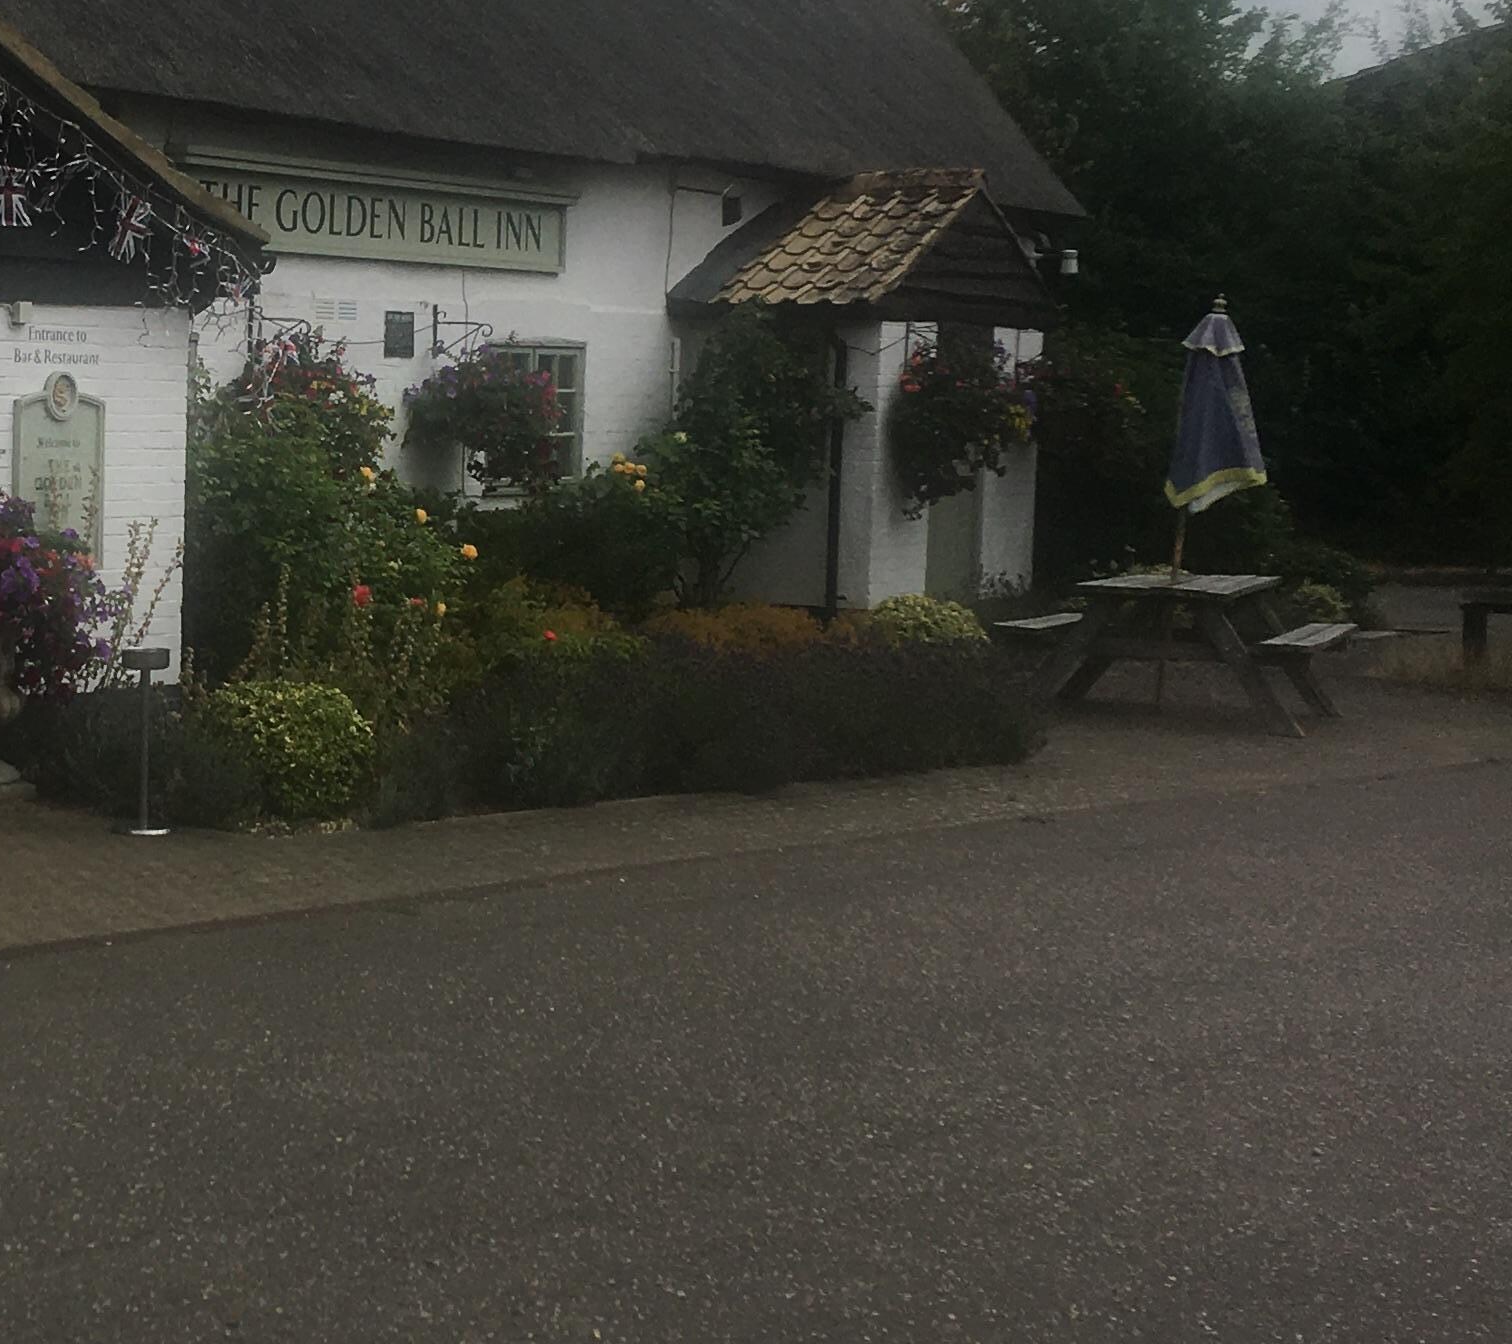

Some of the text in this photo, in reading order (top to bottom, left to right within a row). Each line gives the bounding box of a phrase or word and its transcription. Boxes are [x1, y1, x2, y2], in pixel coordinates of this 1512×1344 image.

[275, 188, 406, 240] GOLDEN
[419, 202, 485, 249] BALL
[496, 210, 541, 252] INN
[28, 325, 87, 343] Entrance to
[14, 347, 100, 365] Bar & Restaurant
